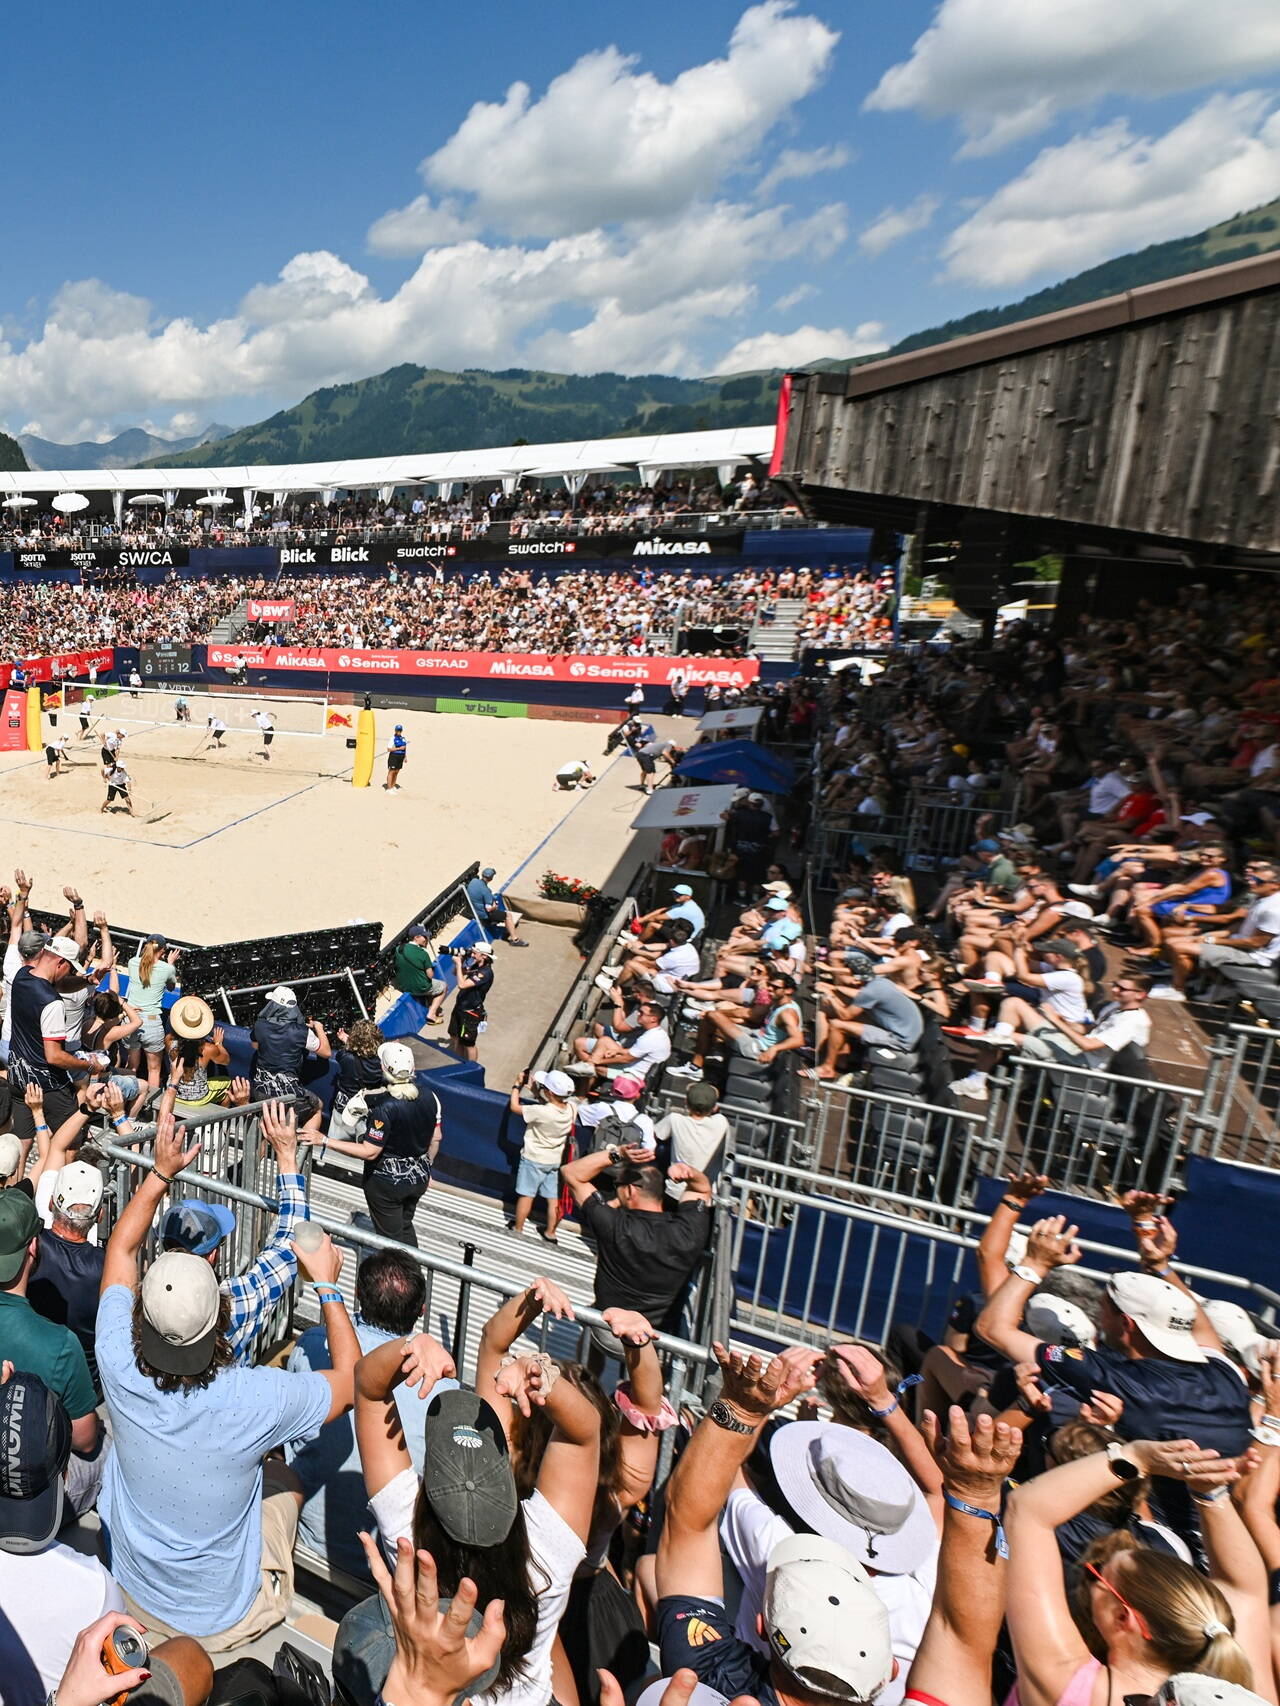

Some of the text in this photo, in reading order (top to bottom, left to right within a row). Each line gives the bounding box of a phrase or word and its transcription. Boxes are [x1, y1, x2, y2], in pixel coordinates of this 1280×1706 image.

[397, 545, 447, 558] swatch
[508, 541, 565, 554] swatch
[633, 537, 712, 555] MIKASA
[281, 549, 316, 563] Blick
[331, 546, 370, 562] Blick
[263, 606, 291, 616] BWT
[224, 653, 264, 664] Seoh
[276, 653, 326, 667] MIKASA
[352, 658, 399, 669] Senoh
[416, 659, 469, 669] GSTAAD
[145, 664, 153, 674] 9
[177, 663, 189, 673] 12
[489, 659, 554, 676] MIKASA
[587, 664, 649, 678] Senoh
[666, 664, 744, 683] MIKASA
[477, 703, 498, 714] bls
